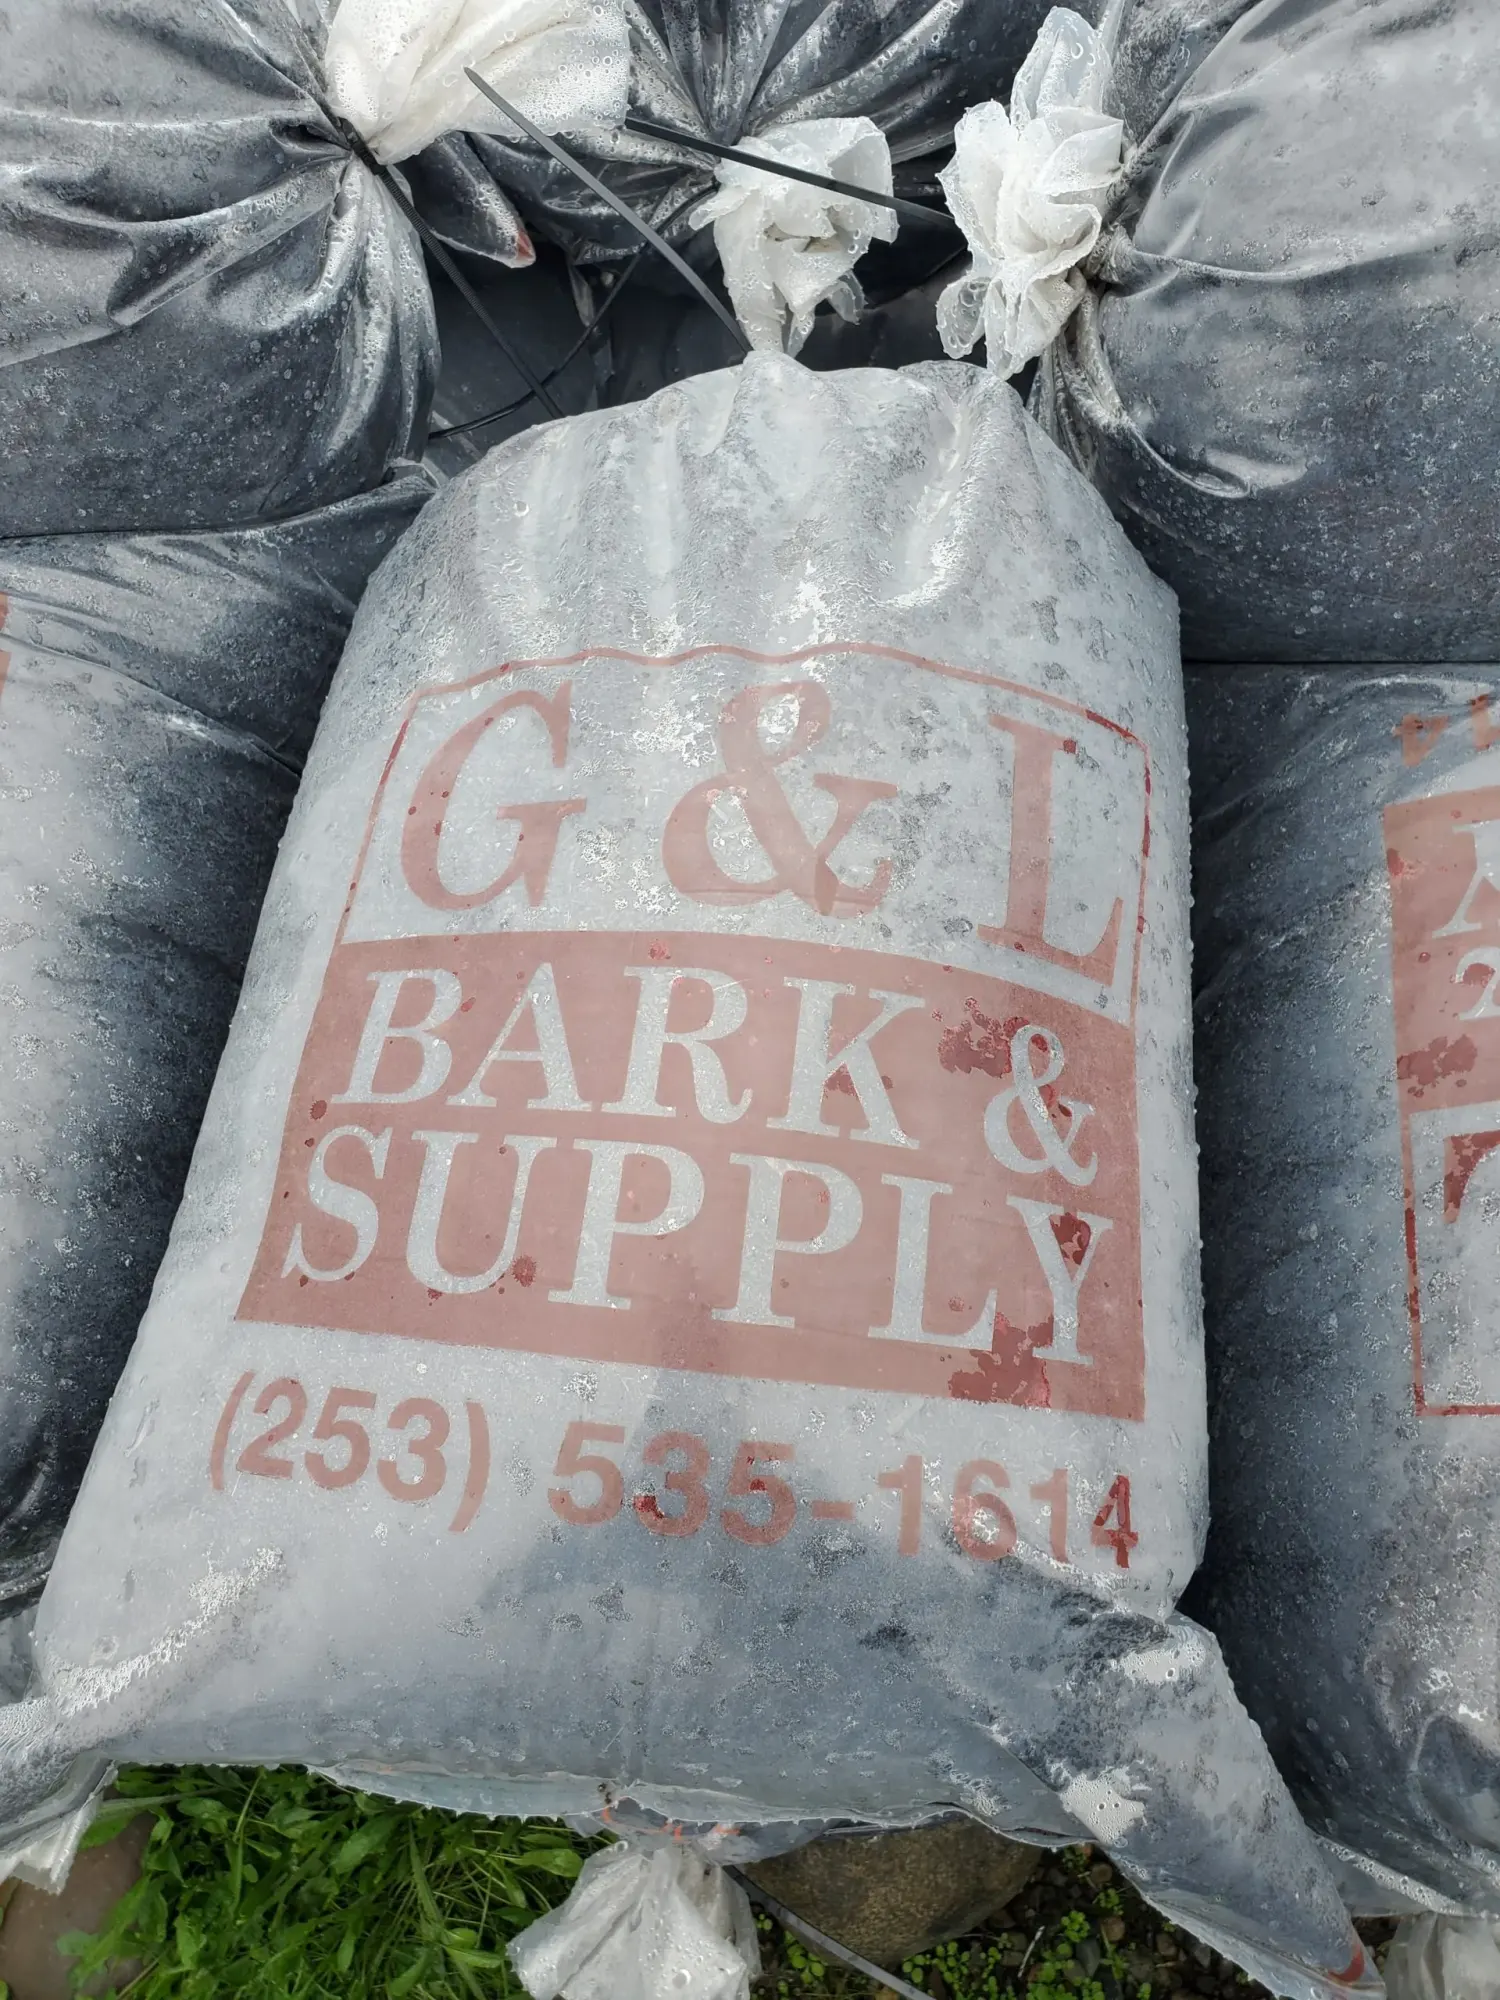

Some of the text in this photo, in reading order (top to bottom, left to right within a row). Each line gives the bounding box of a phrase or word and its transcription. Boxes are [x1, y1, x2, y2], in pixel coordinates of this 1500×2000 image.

[400, 679, 1124, 988] G & L
[331, 962, 1097, 1187] BARK &
[281, 1125, 1113, 1365] SUPPLY
[211, 1371, 1139, 1568] (253) 535-1614
